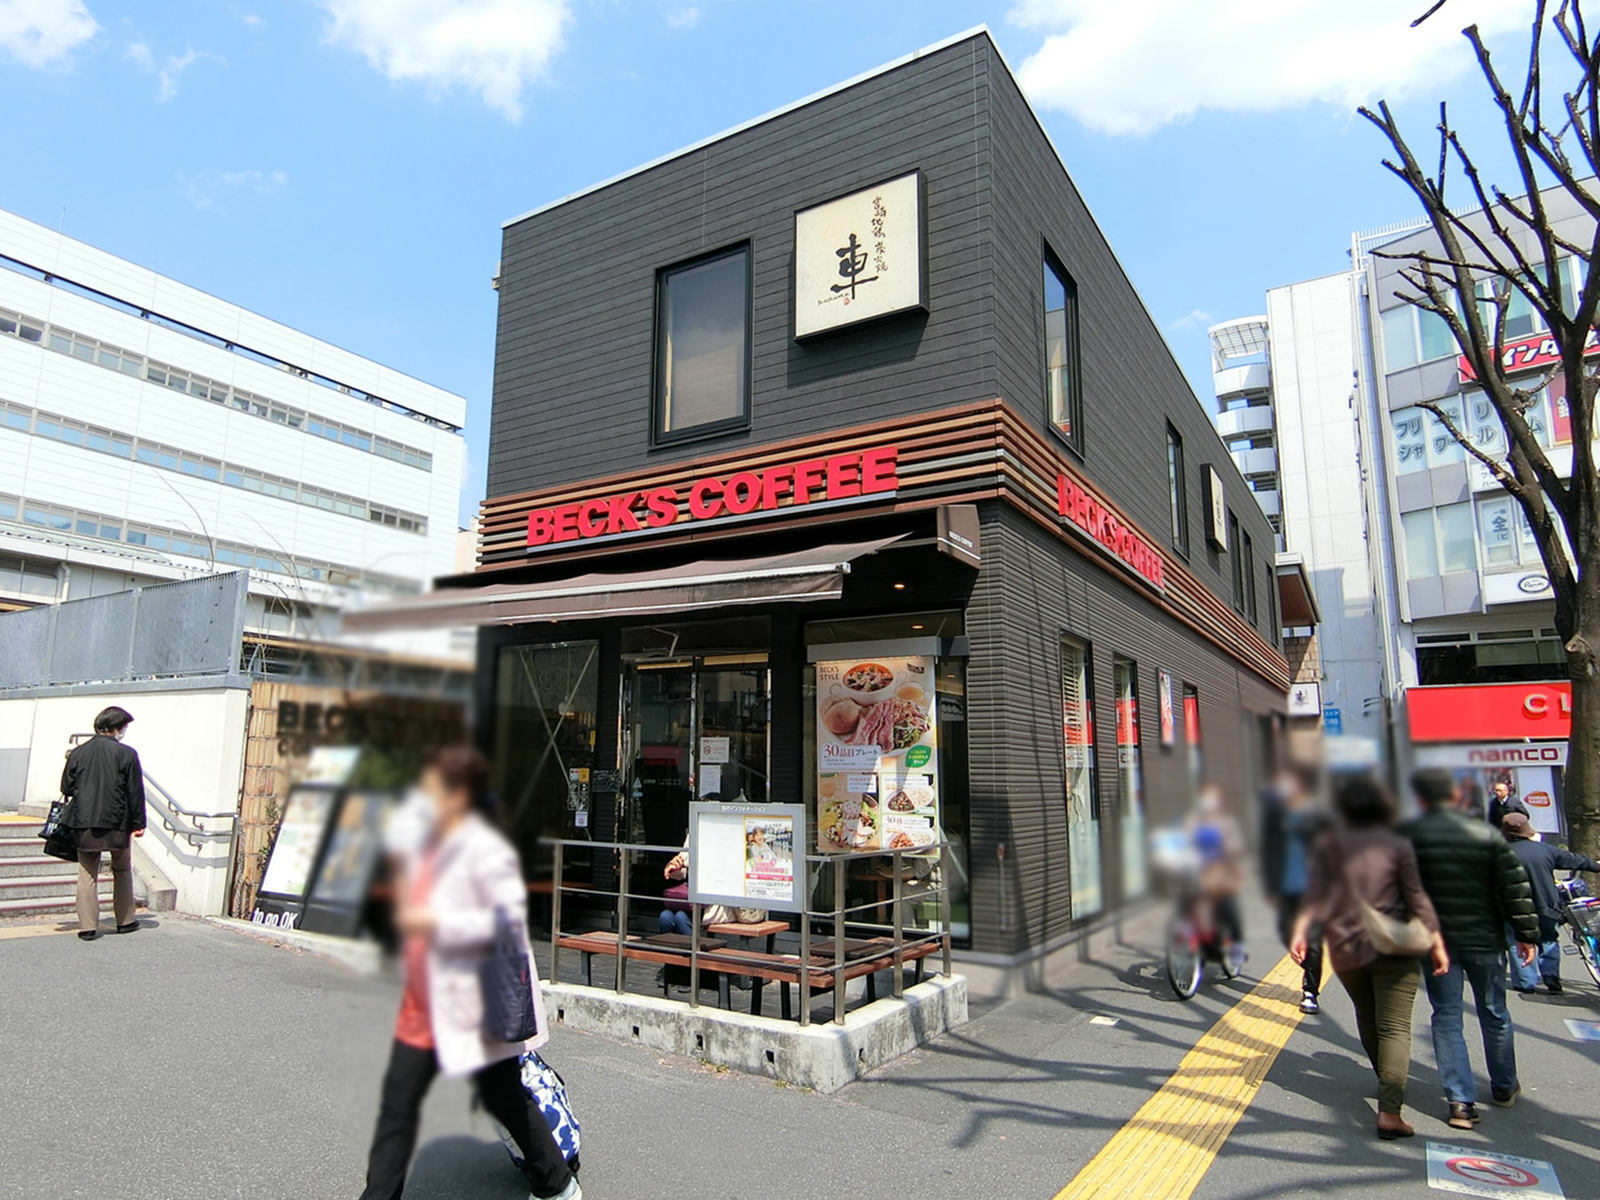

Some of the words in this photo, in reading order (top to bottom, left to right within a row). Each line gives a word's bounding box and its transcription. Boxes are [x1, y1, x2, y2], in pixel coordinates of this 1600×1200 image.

[830, 233, 879, 299] 車
[527, 487, 679, 546] BECK'S
[689, 446, 899, 519] COFFEE
[1057, 474, 1119, 555] BECK'S
[1524, 693, 1572, 713] CL
[1468, 748, 1559, 762] namco
[252, 907, 264, 923] to
[280, 911, 298, 930] OK
